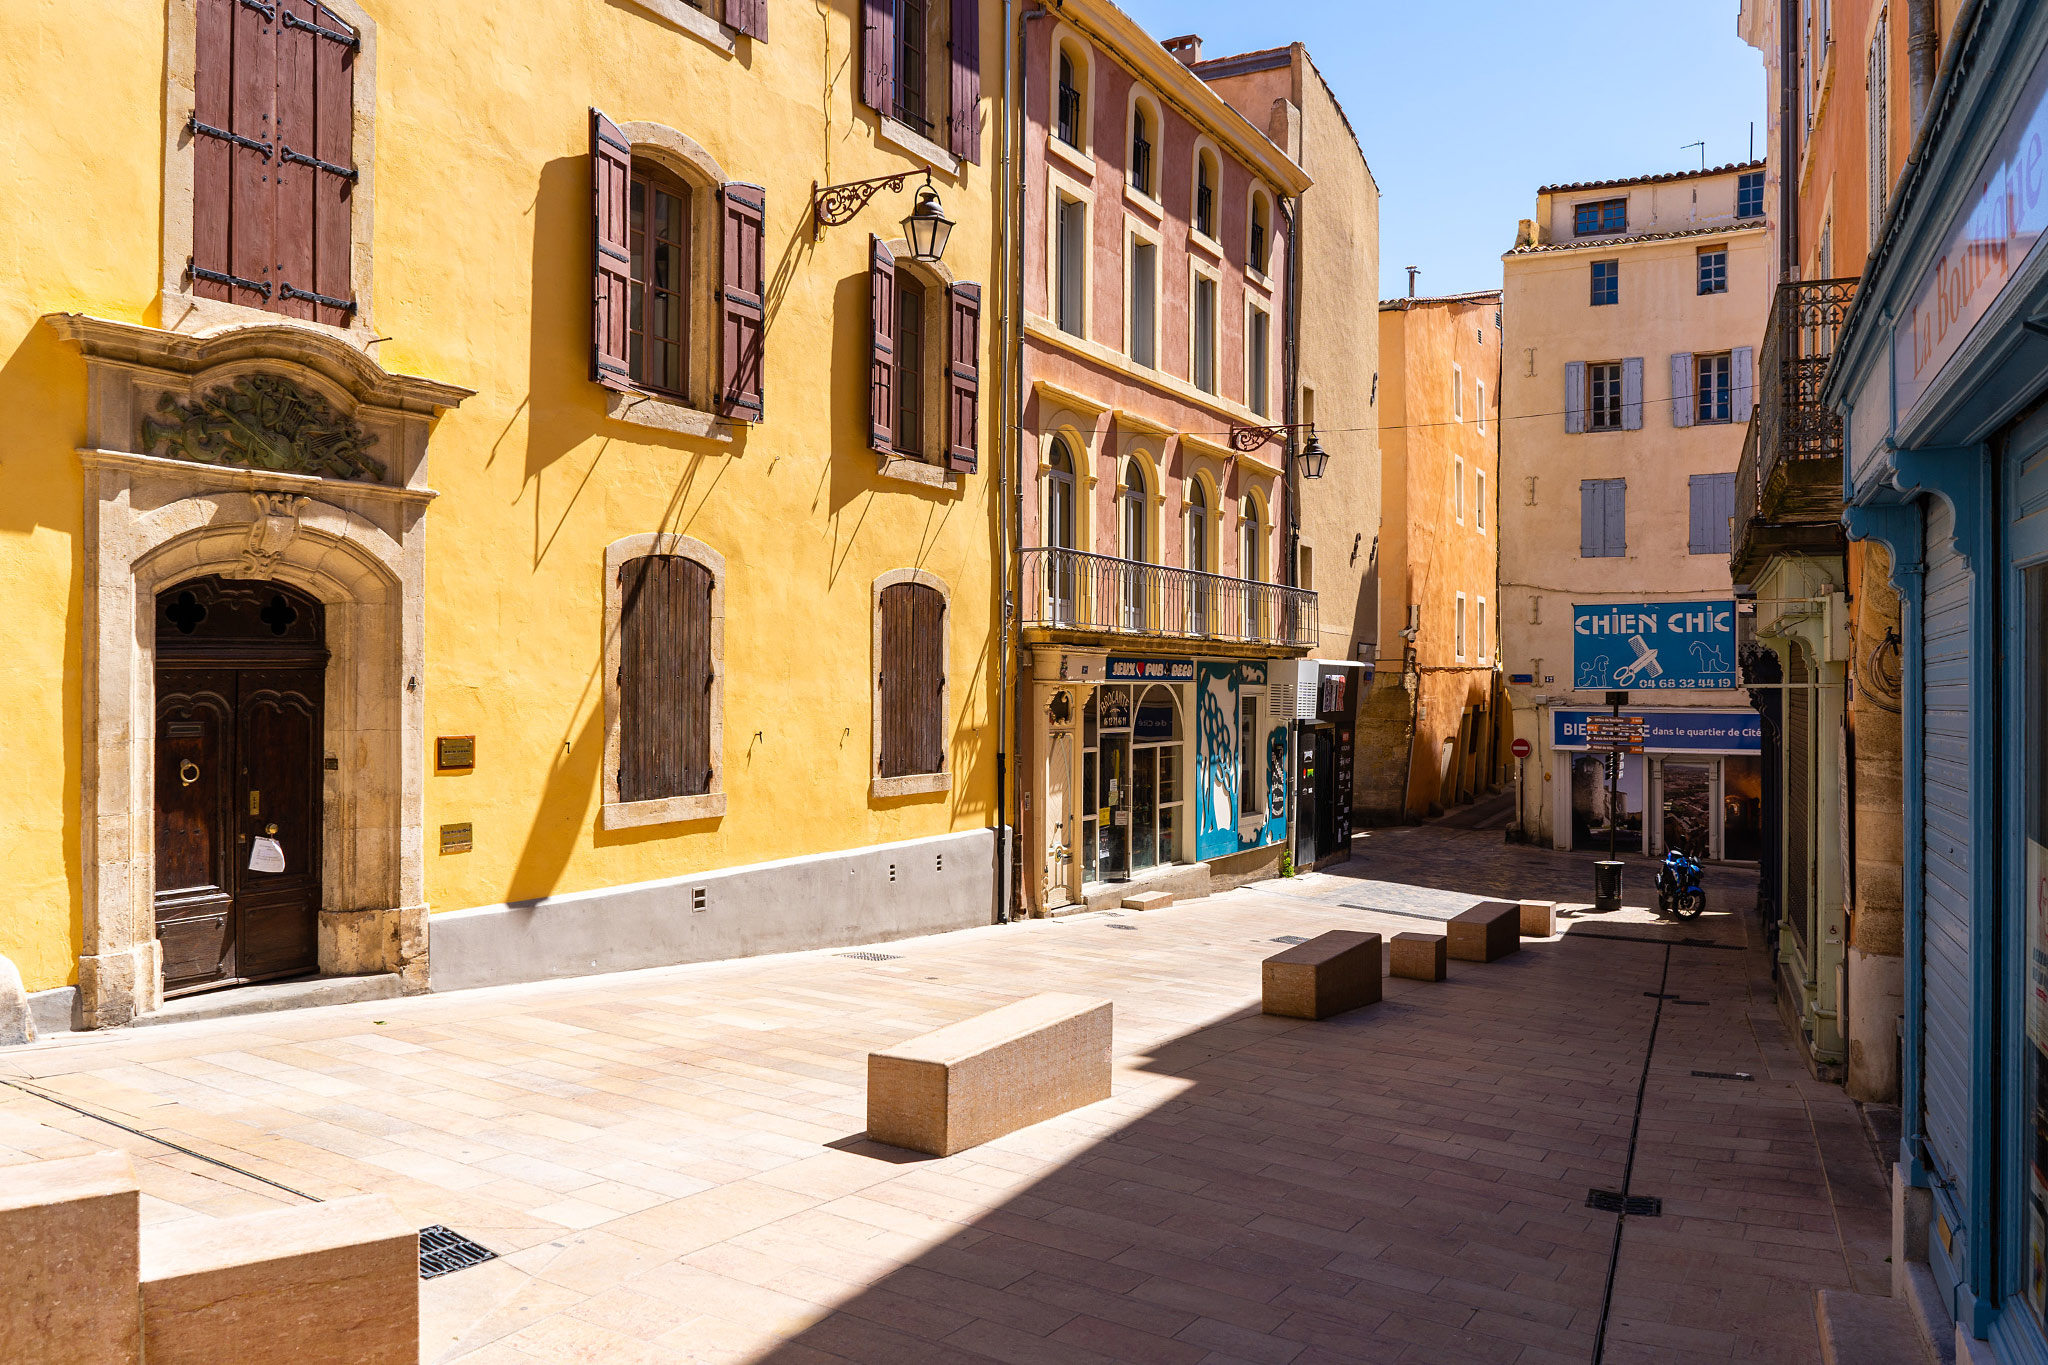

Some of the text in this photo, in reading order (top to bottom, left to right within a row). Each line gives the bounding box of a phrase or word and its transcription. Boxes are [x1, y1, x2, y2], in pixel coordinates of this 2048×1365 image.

[1912, 131, 2044, 380] La Boutique
[1112, 661, 1136, 676] JEUX
[1145, 663, 1164, 677] PUB
[1639, 678, 1731, 688] 04 68 32 44 19
[1100, 690, 1130, 715] BROCANTE
[1652, 727, 1674, 736] dans
[1676, 727, 1685, 736] le
[1687, 728, 1726, 738] quartier
[1728, 728, 1740, 737] de
[1742, 728, 1761, 737] Cité
